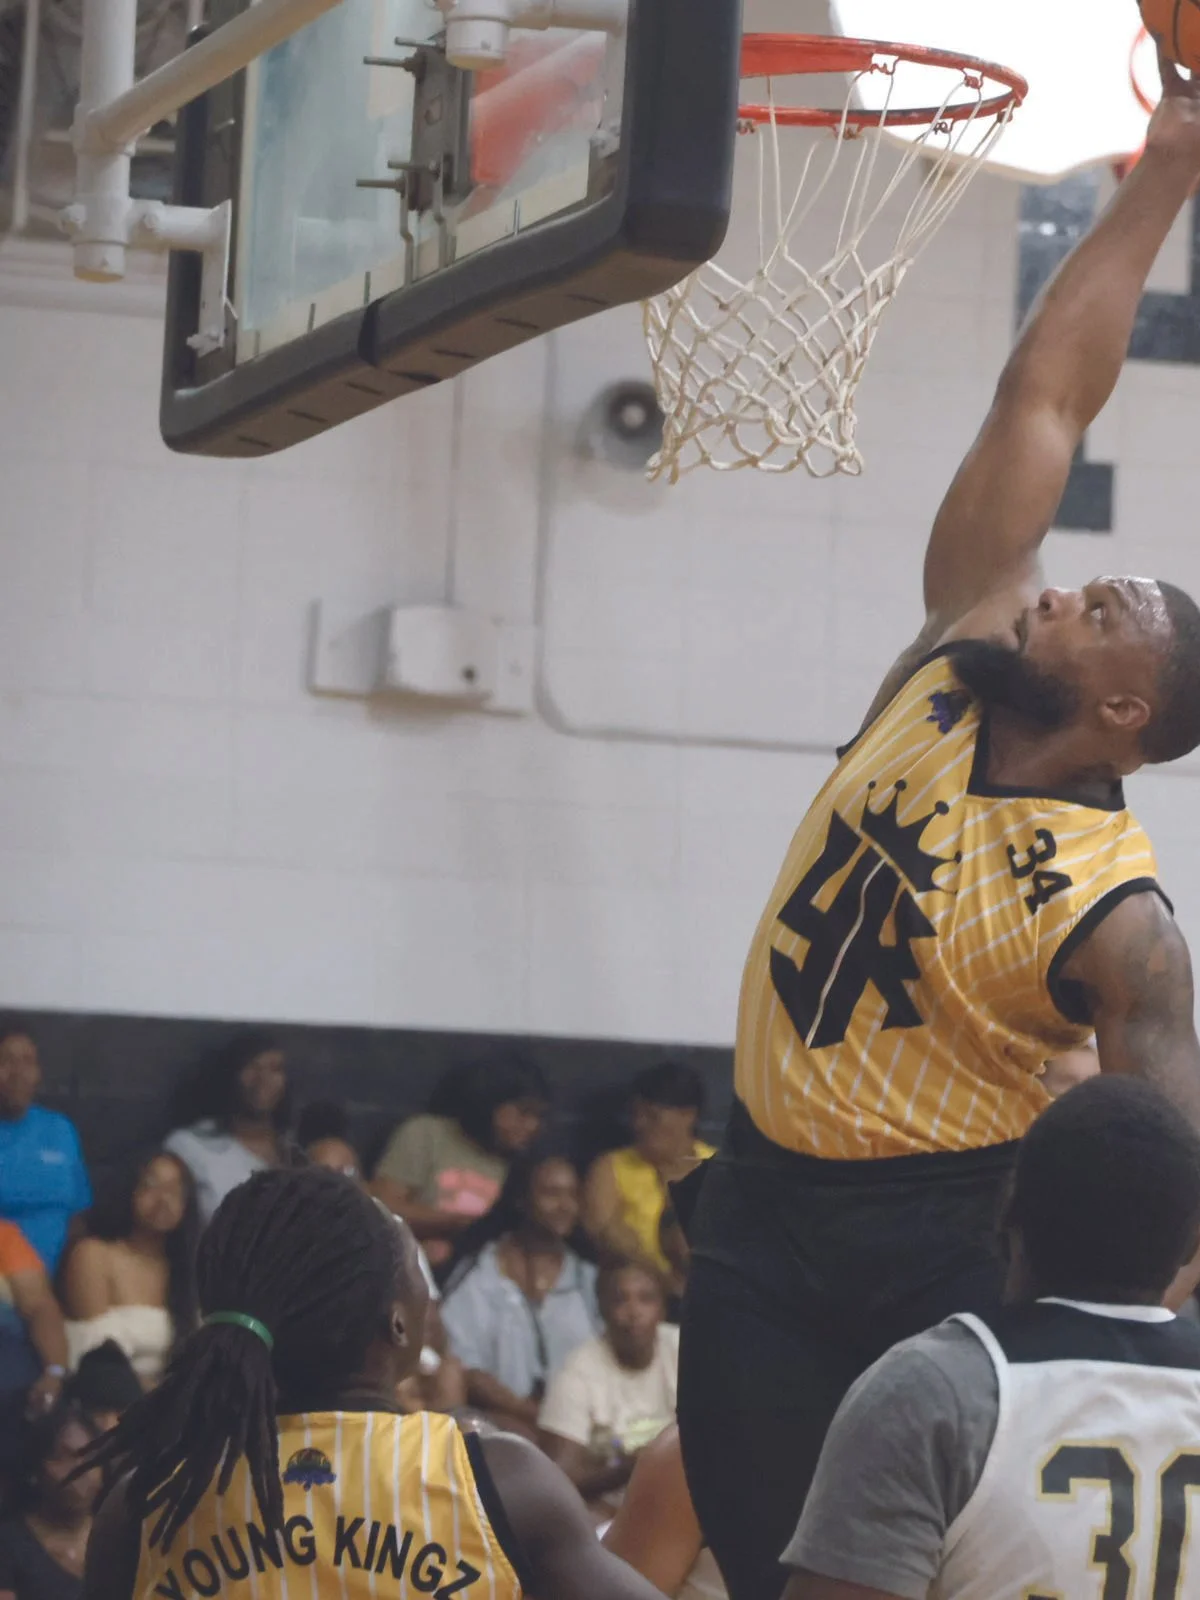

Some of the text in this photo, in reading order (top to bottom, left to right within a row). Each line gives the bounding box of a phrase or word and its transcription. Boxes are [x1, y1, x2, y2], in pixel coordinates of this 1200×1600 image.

[1004, 828, 1073, 915] 34
[154, 1514, 481, 1600] YOUNG KINGZ
